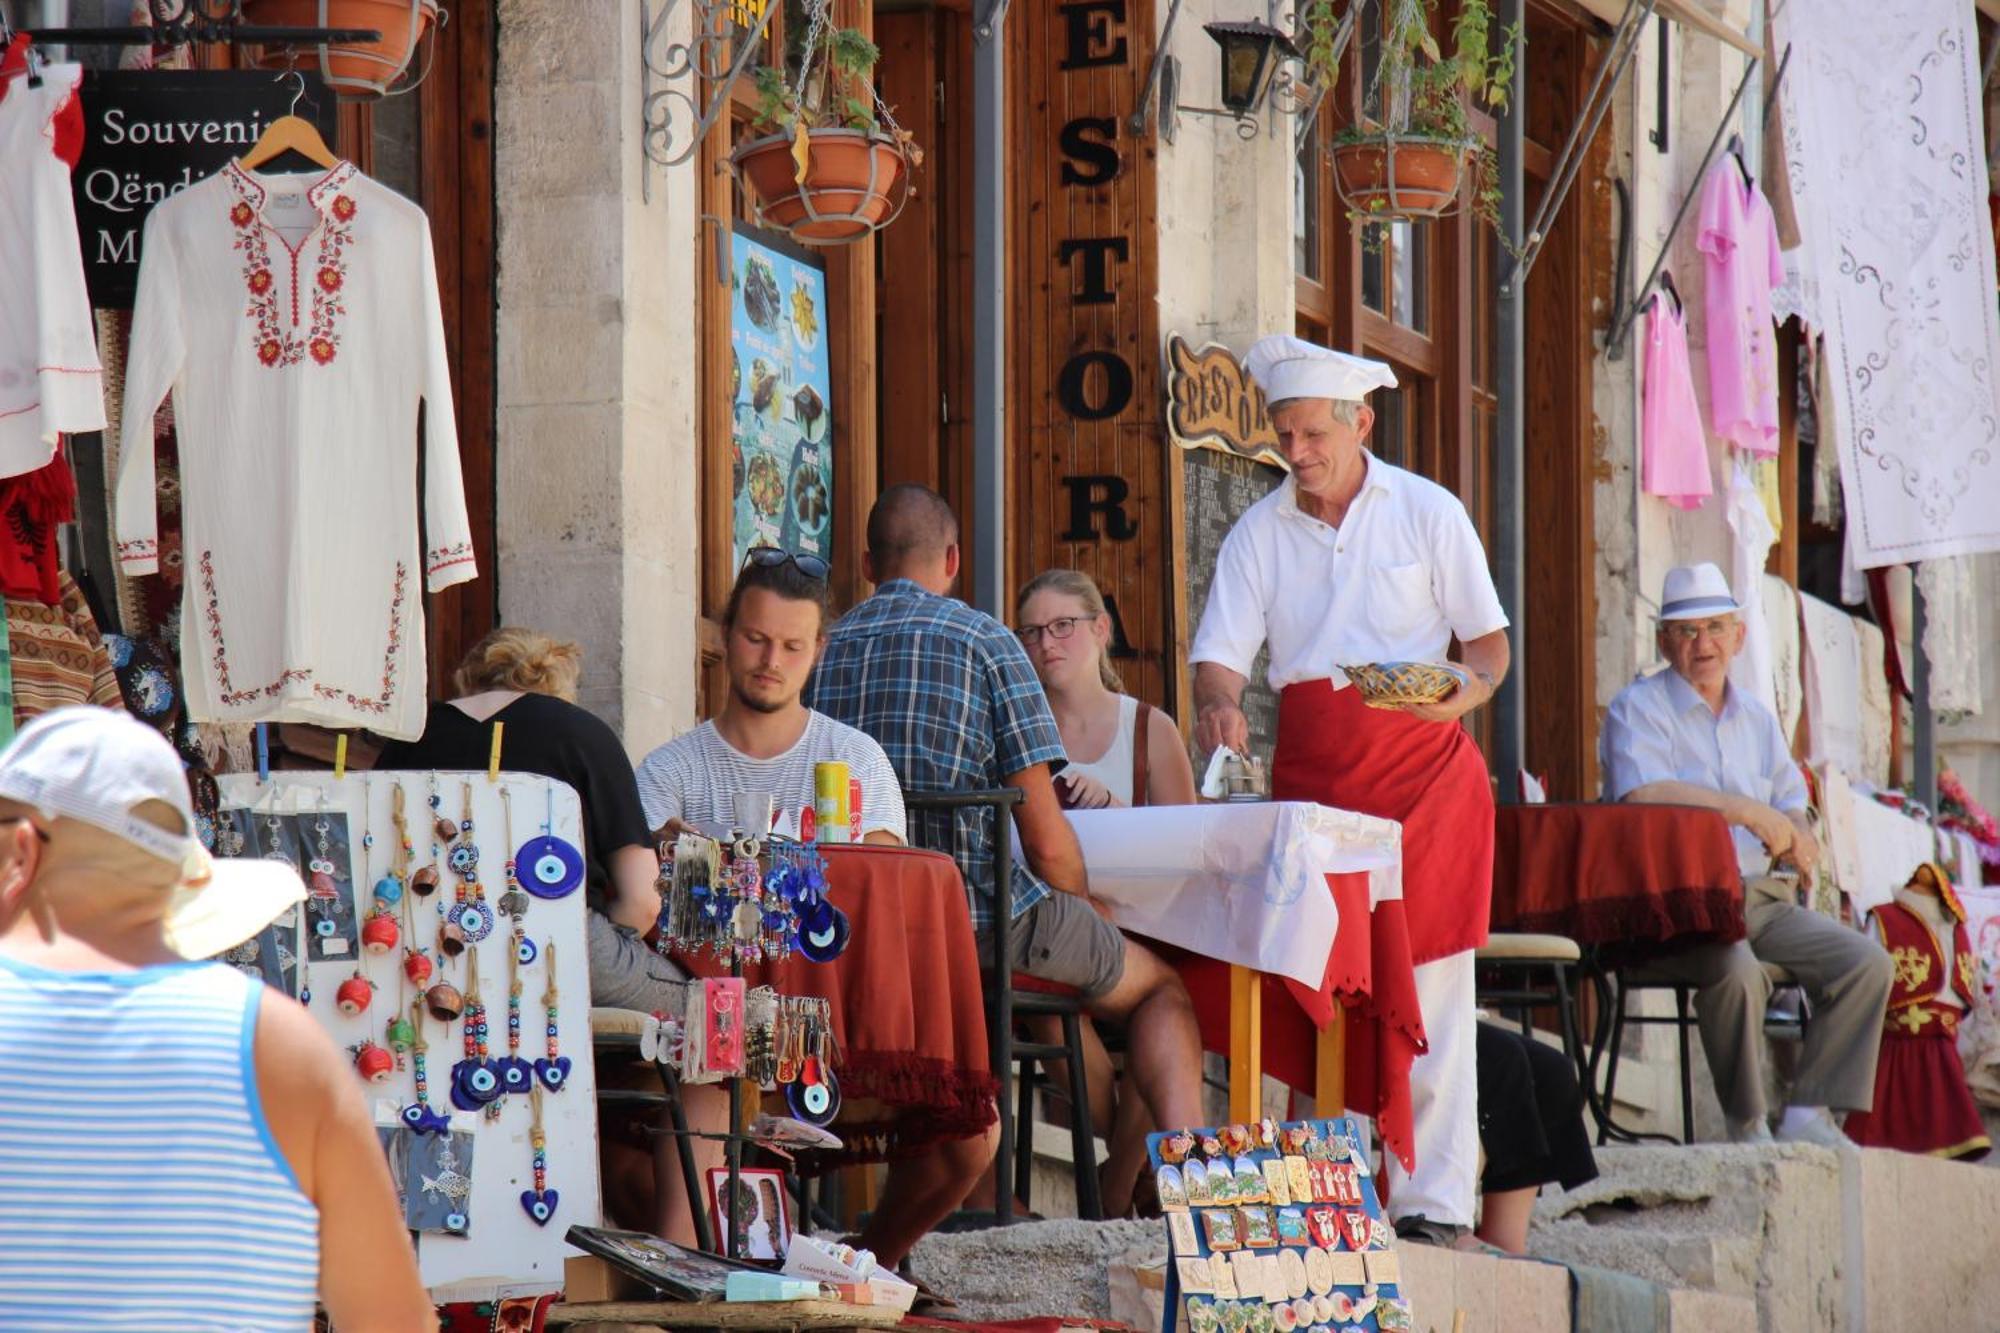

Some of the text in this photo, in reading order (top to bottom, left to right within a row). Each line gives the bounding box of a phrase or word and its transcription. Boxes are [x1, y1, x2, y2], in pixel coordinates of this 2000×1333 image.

[103, 109, 271, 145] Souveni
[85, 166, 204, 212] Qënd
[1186, 365, 1273, 441] RESTOR
[1207, 451, 1256, 480] MENY
